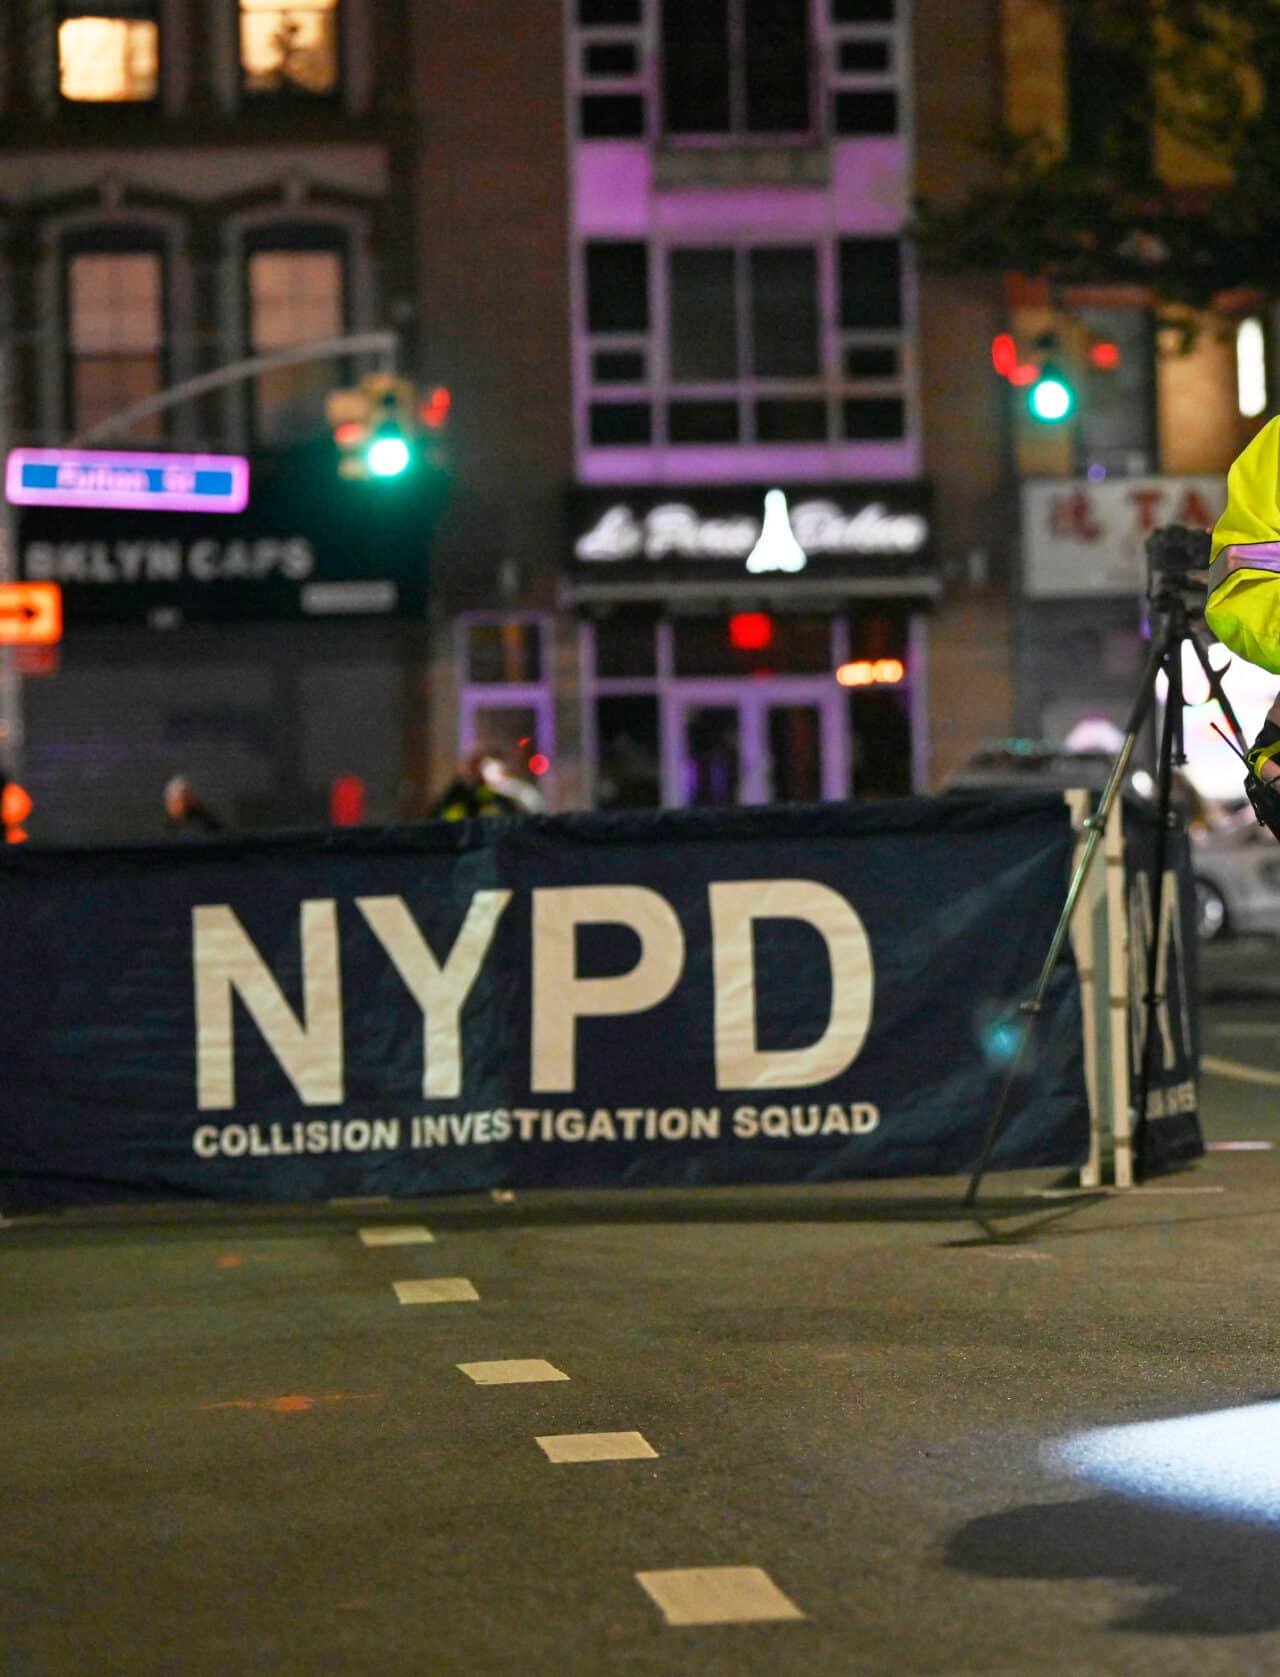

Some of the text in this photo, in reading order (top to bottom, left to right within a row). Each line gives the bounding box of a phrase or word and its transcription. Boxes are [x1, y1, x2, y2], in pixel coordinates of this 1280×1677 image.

[187, 536, 313, 580] CAPS
[191, 878, 876, 1111] NYPD
[193, 1101, 881, 1157] COLLISION INVESTIGATION SQUAD
